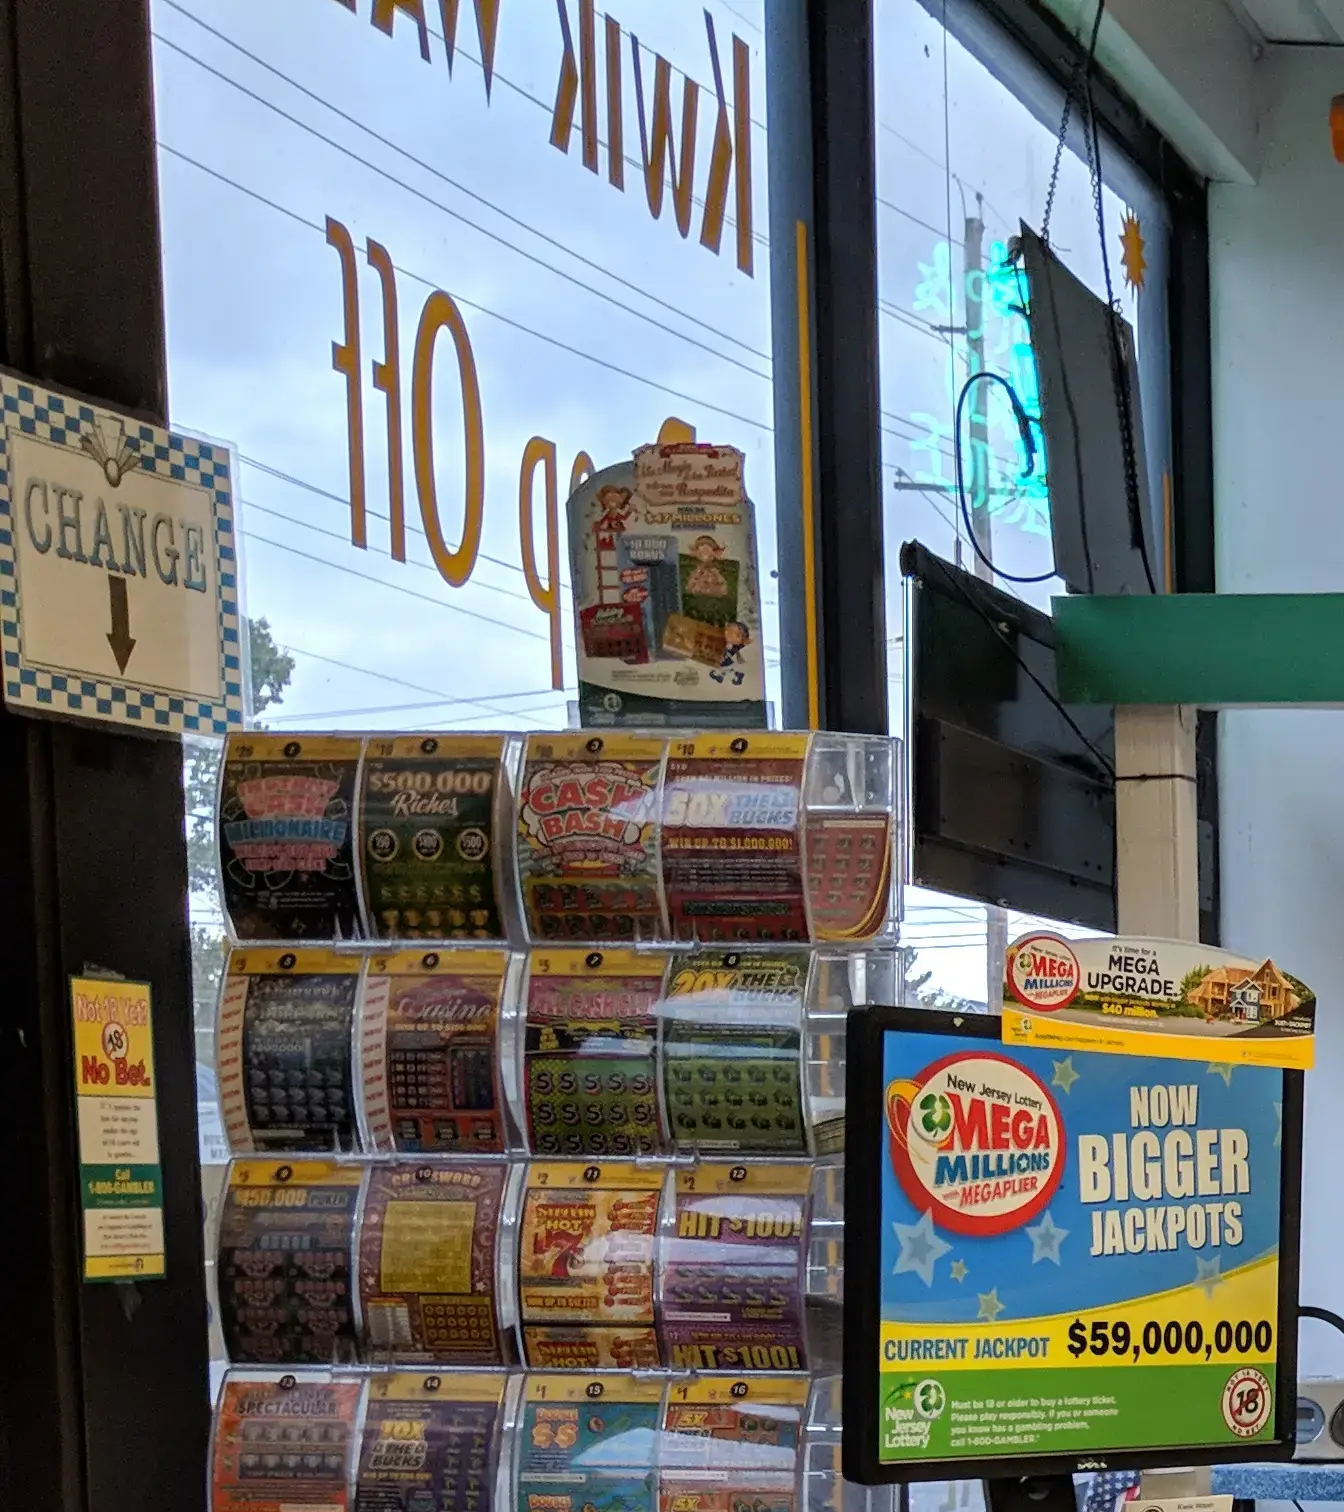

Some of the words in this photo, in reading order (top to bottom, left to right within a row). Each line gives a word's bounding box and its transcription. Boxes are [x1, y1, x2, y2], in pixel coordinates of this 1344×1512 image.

[23, 478, 206, 594] CHANGE
[390, 791, 459, 818] Riches
[529, 776, 642, 814] CASH
[665, 789, 729, 826] 50X
[541, 810, 625, 842] BASH
[1026, 954, 1074, 978] MEGA
[1108, 955, 1160, 976] MEGA
[1024, 978, 1073, 991] MILLIONS
[1087, 972, 1178, 997] UPGRADE.
[82, 1055, 109, 1085] No
[115, 1057, 151, 1086] Bet.
[947, 1073, 976, 1093] New
[979, 1083, 1012, 1104] Jersey
[1014, 1092, 1043, 1111] Lottery
[1130, 1085, 1199, 1128] NOW
[938, 1091, 1051, 1153] MEGA
[933, 1152, 1050, 1187] MILLIONS
[1078, 1129, 1250, 1203] BIGGER
[959, 1176, 1038, 1208] MEGAPLIER
[679, 1212, 721, 1238] HIT
[729, 1212, 802, 1238] $100!
[1090, 1201, 1243, 1256] JACKPOTS
[884, 1338, 969, 1361] CURRENT
[973, 1337, 1051, 1360] JACKPOT
[1067, 1318, 1273, 1363] $59,000,000
[672, 1345, 717, 1368] HIT
[723, 1346, 800, 1369] $100!
[884, 1406, 914, 1422] New
[890, 1420, 932, 1436] Jersey
[884, 1433, 931, 1449] Lottery
